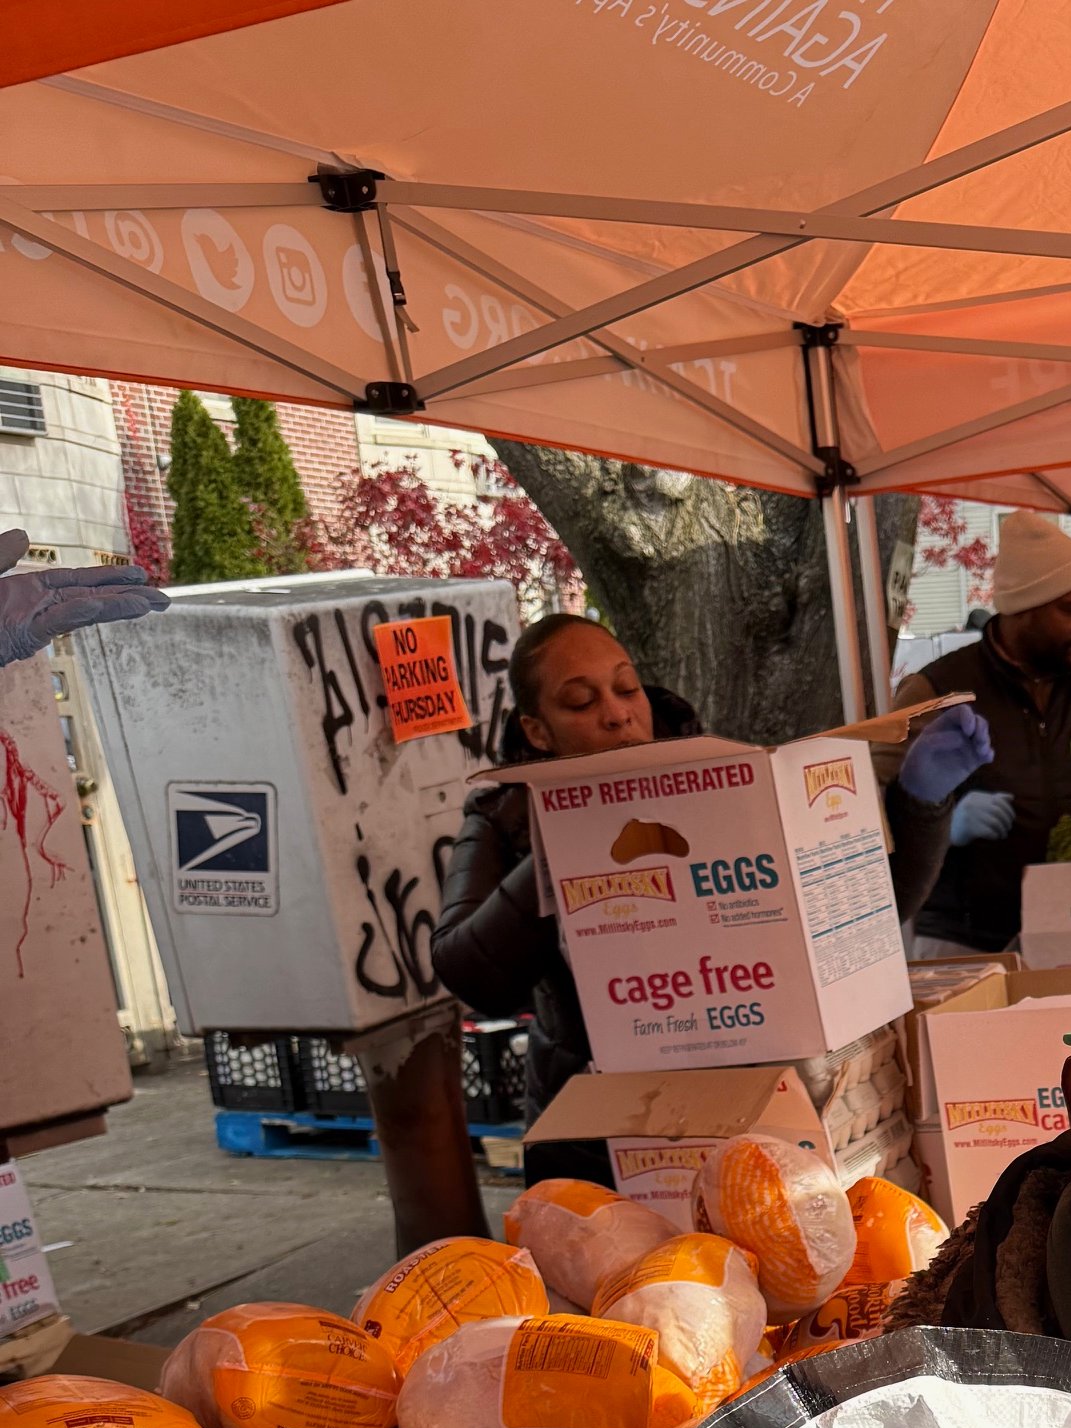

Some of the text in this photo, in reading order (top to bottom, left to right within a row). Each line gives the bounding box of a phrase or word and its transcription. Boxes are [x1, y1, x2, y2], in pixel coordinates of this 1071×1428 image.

[392, 627, 418, 656] NO
[541, 762, 755, 812] KEEP REFRIGERATED
[179, 880, 266, 893] UNITED STATES
[689, 853, 780, 898] EGGS
[179, 894, 272, 909] POSTAL SERVICE
[602, 902, 640, 917] Eggs
[721, 914, 731, 923] No
[731, 911, 751, 922] added
[607, 955, 776, 1012] cage free
[633, 1002, 765, 1036] Farm Fresh EGGS
[1037, 1086, 1066, 1109] EG
[1041, 1113, 1067, 1131] ca
